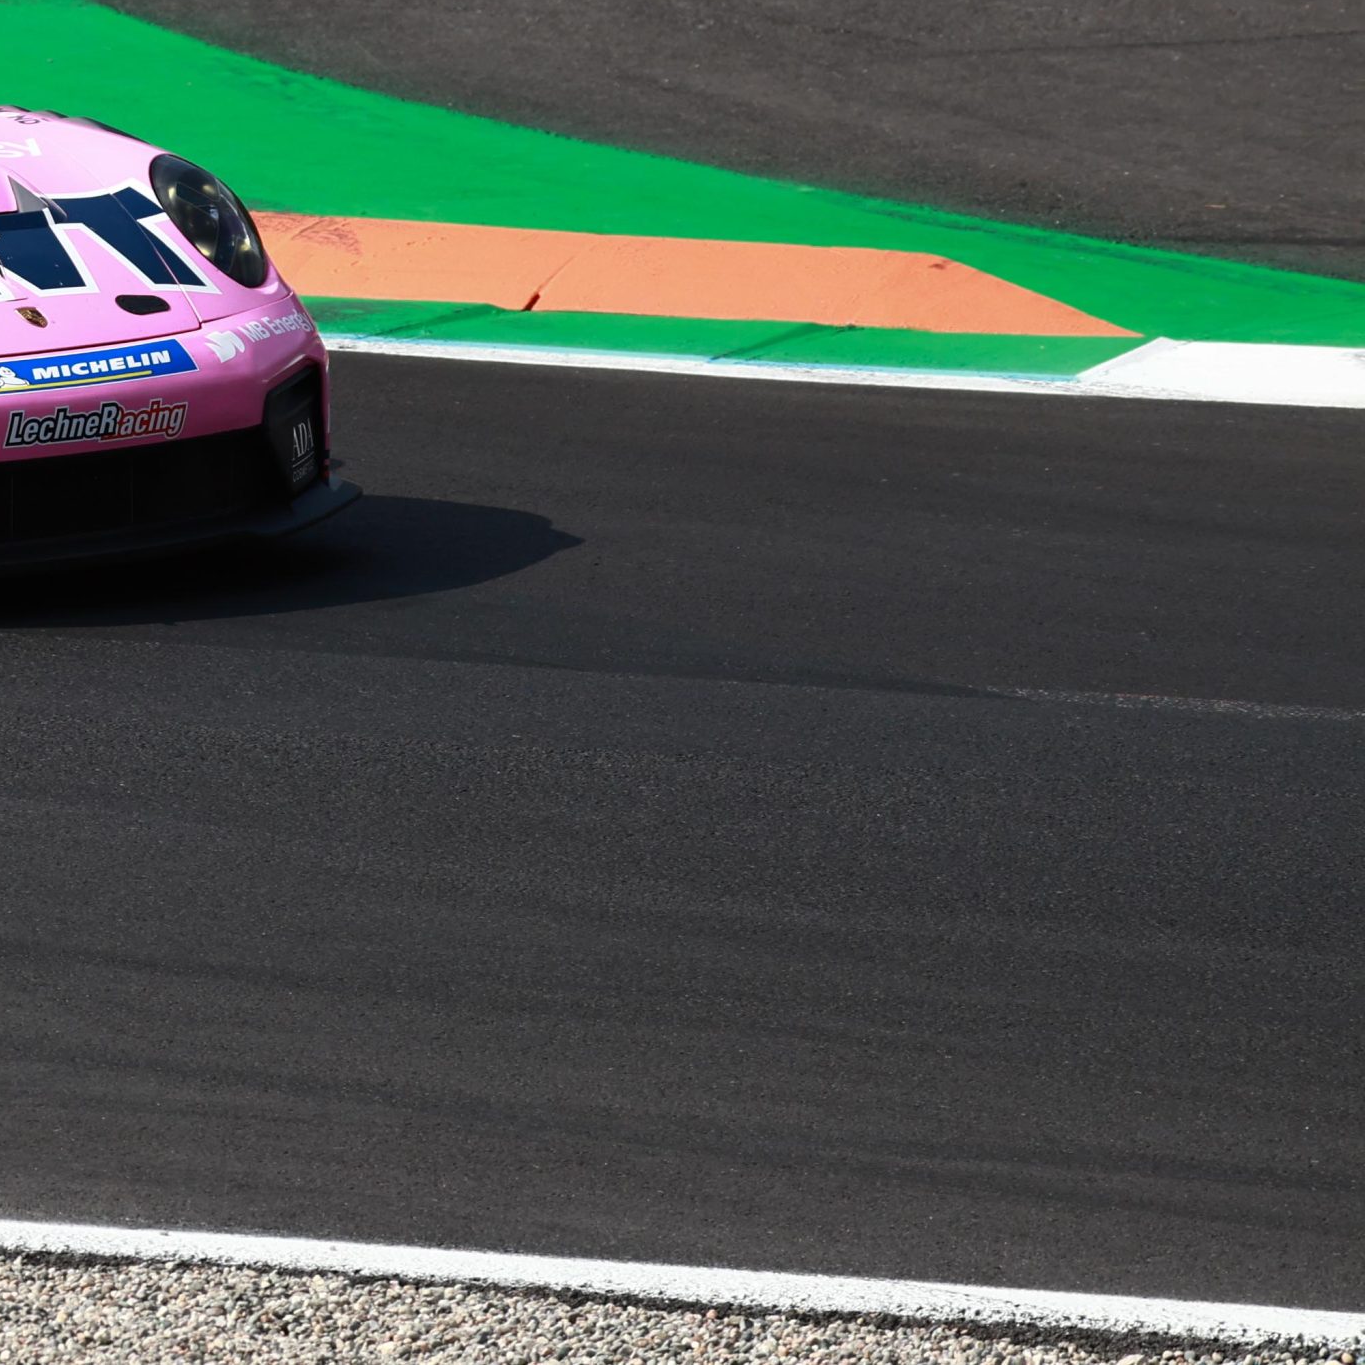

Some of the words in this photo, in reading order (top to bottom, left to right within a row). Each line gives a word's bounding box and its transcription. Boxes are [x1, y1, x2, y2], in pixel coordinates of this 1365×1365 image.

[237, 320, 271, 344] MB
[267, 309, 315, 335] Energy
[32, 350, 173, 382] MICHELIN
[291, 417, 315, 461] ADA
